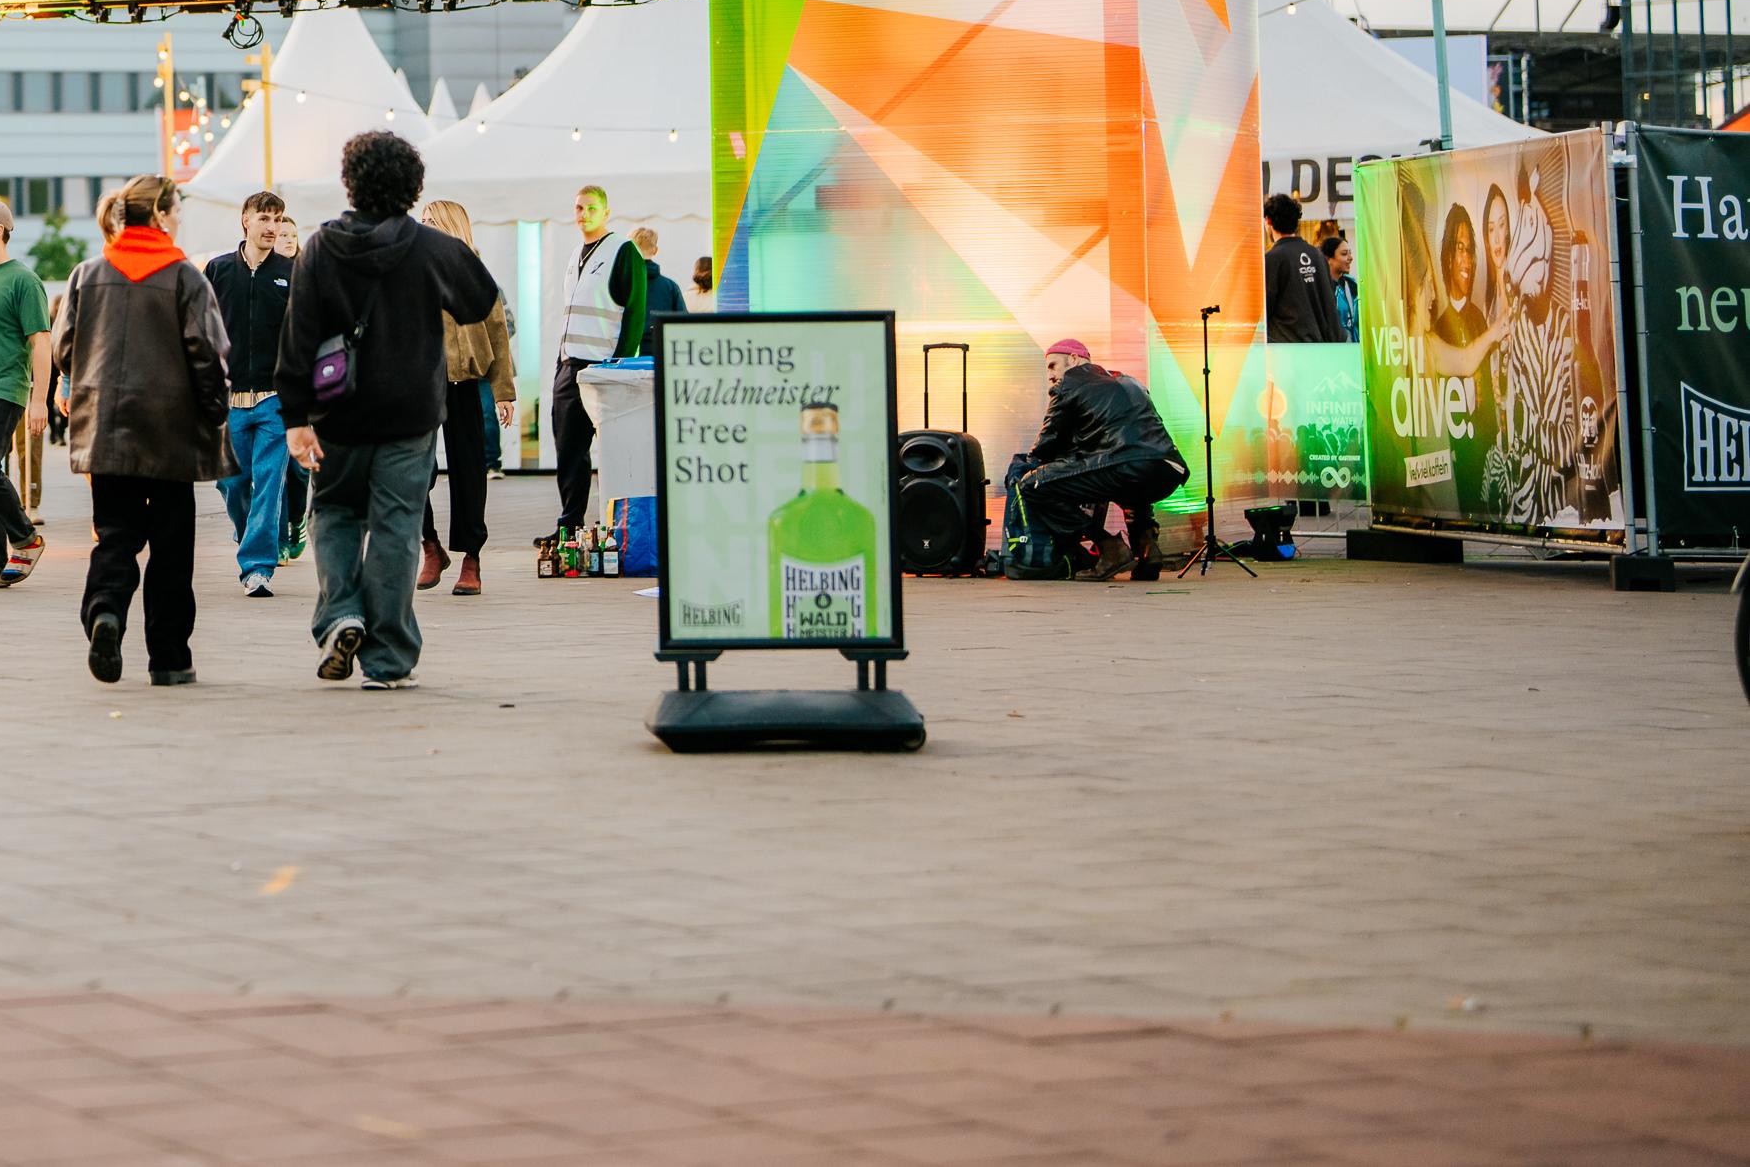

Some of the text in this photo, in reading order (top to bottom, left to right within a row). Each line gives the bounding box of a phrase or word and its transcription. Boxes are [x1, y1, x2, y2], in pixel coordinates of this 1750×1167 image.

[1667, 175, 1750, 240] Ha
[670, 338, 795, 373] Helbing
[673, 377, 841, 407] Waldmeister
[675, 416, 747, 444] Free
[675, 455, 748, 483] Shot
[785, 564, 861, 592] HELBING
[682, 603, 741, 626] HELBING
[801, 611, 847, 626] WALD
